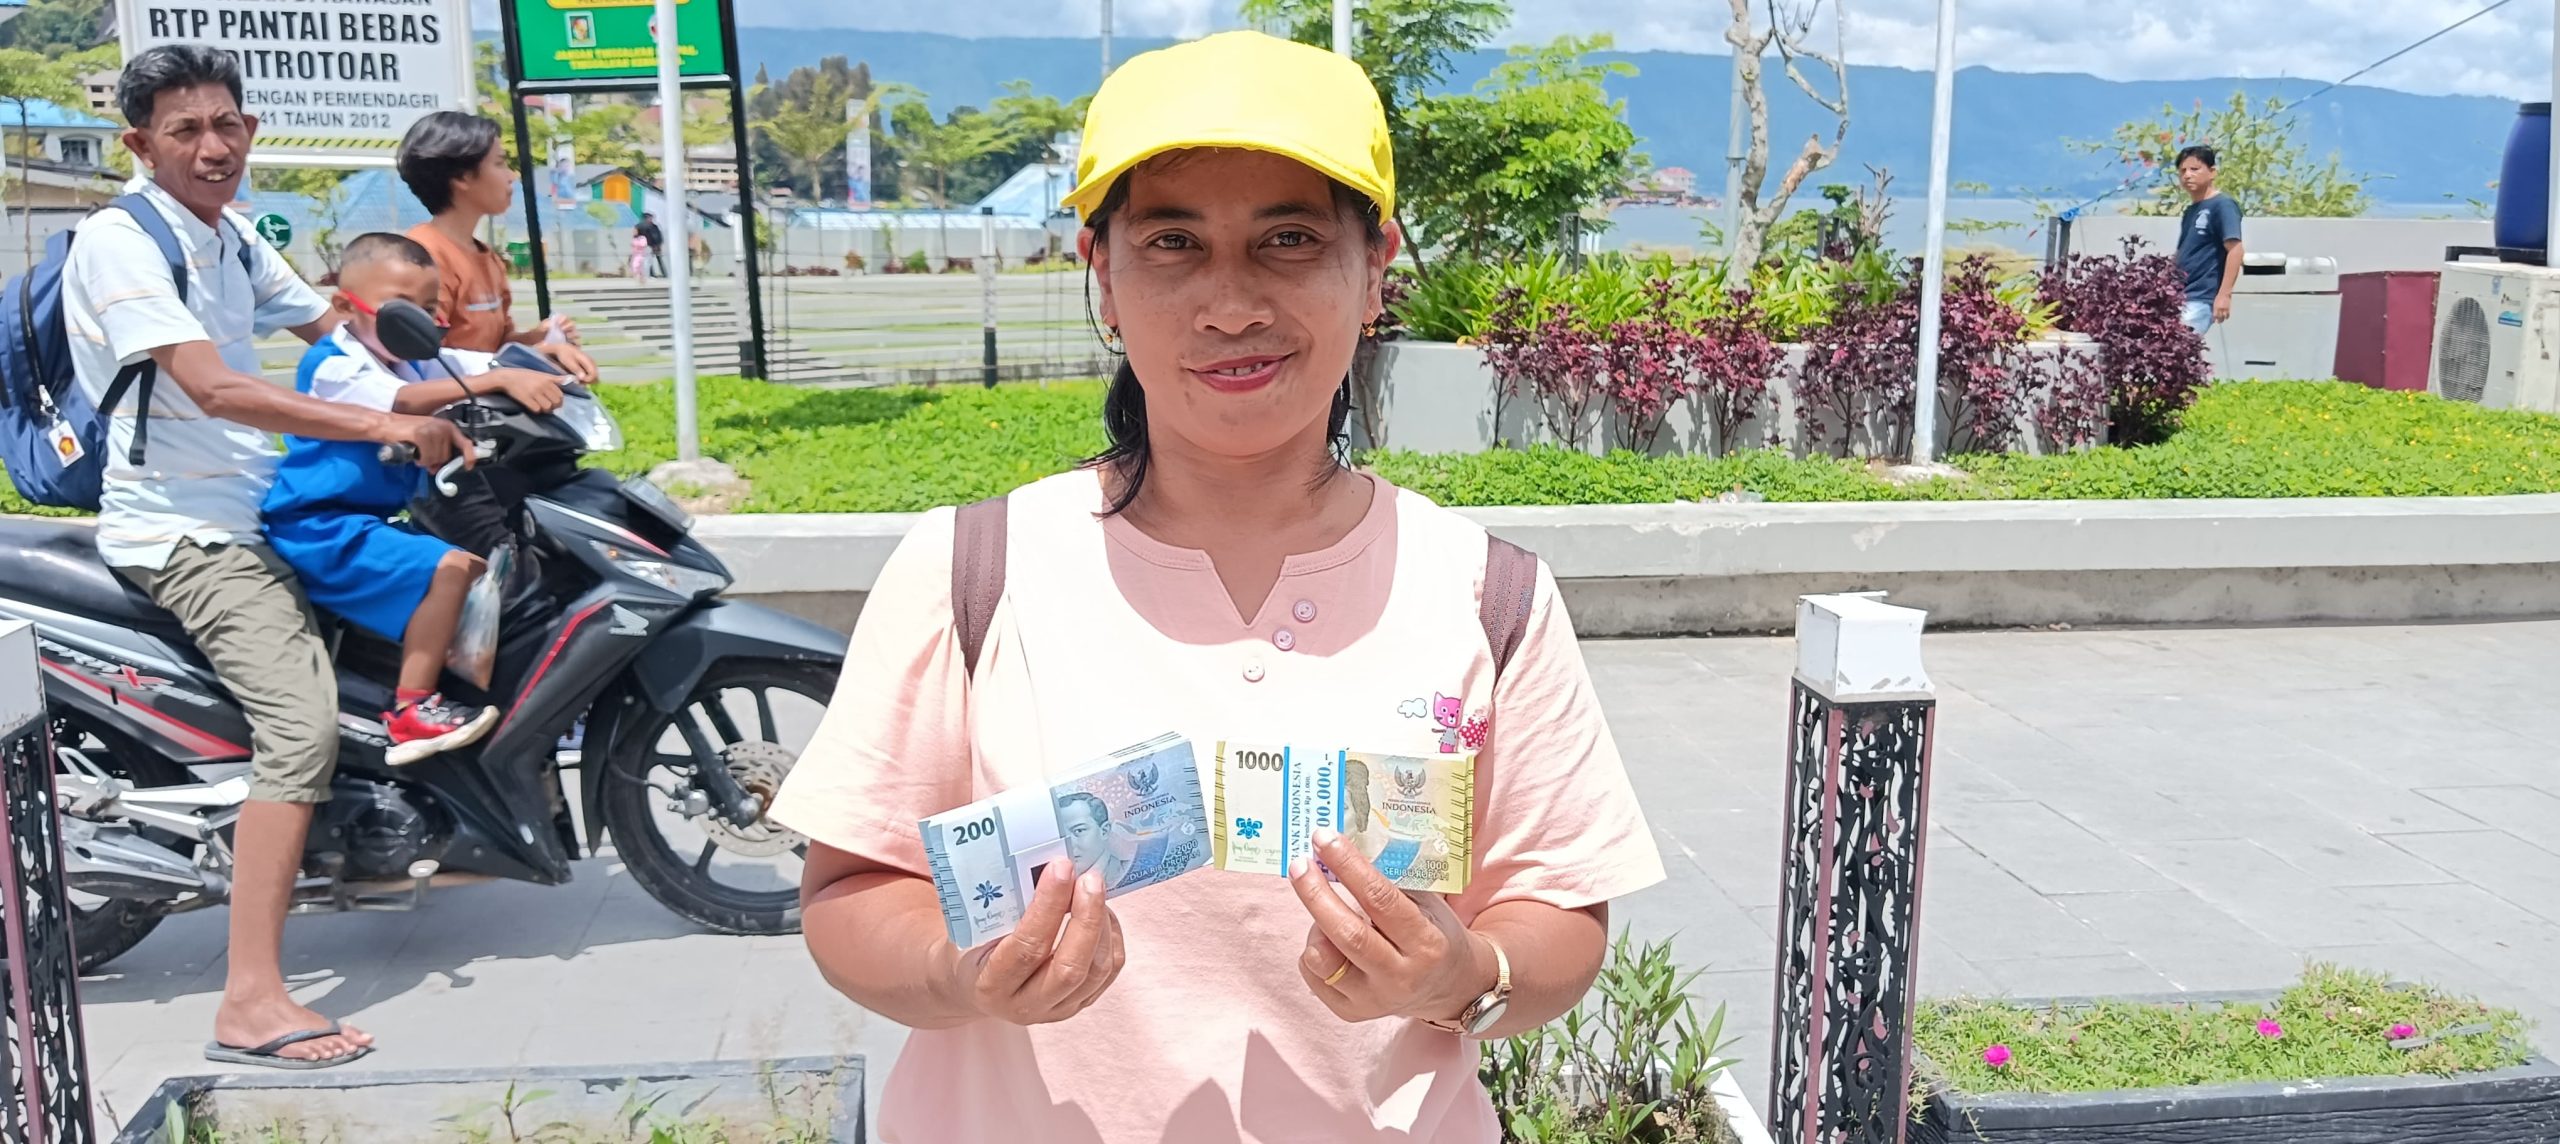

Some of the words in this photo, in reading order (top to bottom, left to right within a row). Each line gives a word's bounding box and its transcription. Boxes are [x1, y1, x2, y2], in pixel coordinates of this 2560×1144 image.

[149, 8, 209, 38] RTP
[219, 9, 329, 41] PANTAI
[339, 12, 440, 44] BEBAS
[246, 89, 308, 106] ENGAN
[313, 91, 440, 109] PERMENDAGRI
[258, 111, 278, 126] 41
[284, 111, 345, 128] TAHUN
[350, 113, 392, 129] 2012
[1235, 750, 1284, 772] 1000
[1291, 762, 1302, 827] INDONESIA
[1316, 753, 1333, 828] 00.000,-
[1124, 795, 1177, 819] INDONESIA
[1382, 802, 1437, 815] INDONESIA
[952, 817, 995, 846] 200
[1175, 839, 1199, 855] 2000
[1129, 869, 1149, 881] DUA
[1426, 860, 1449, 872] 1000
